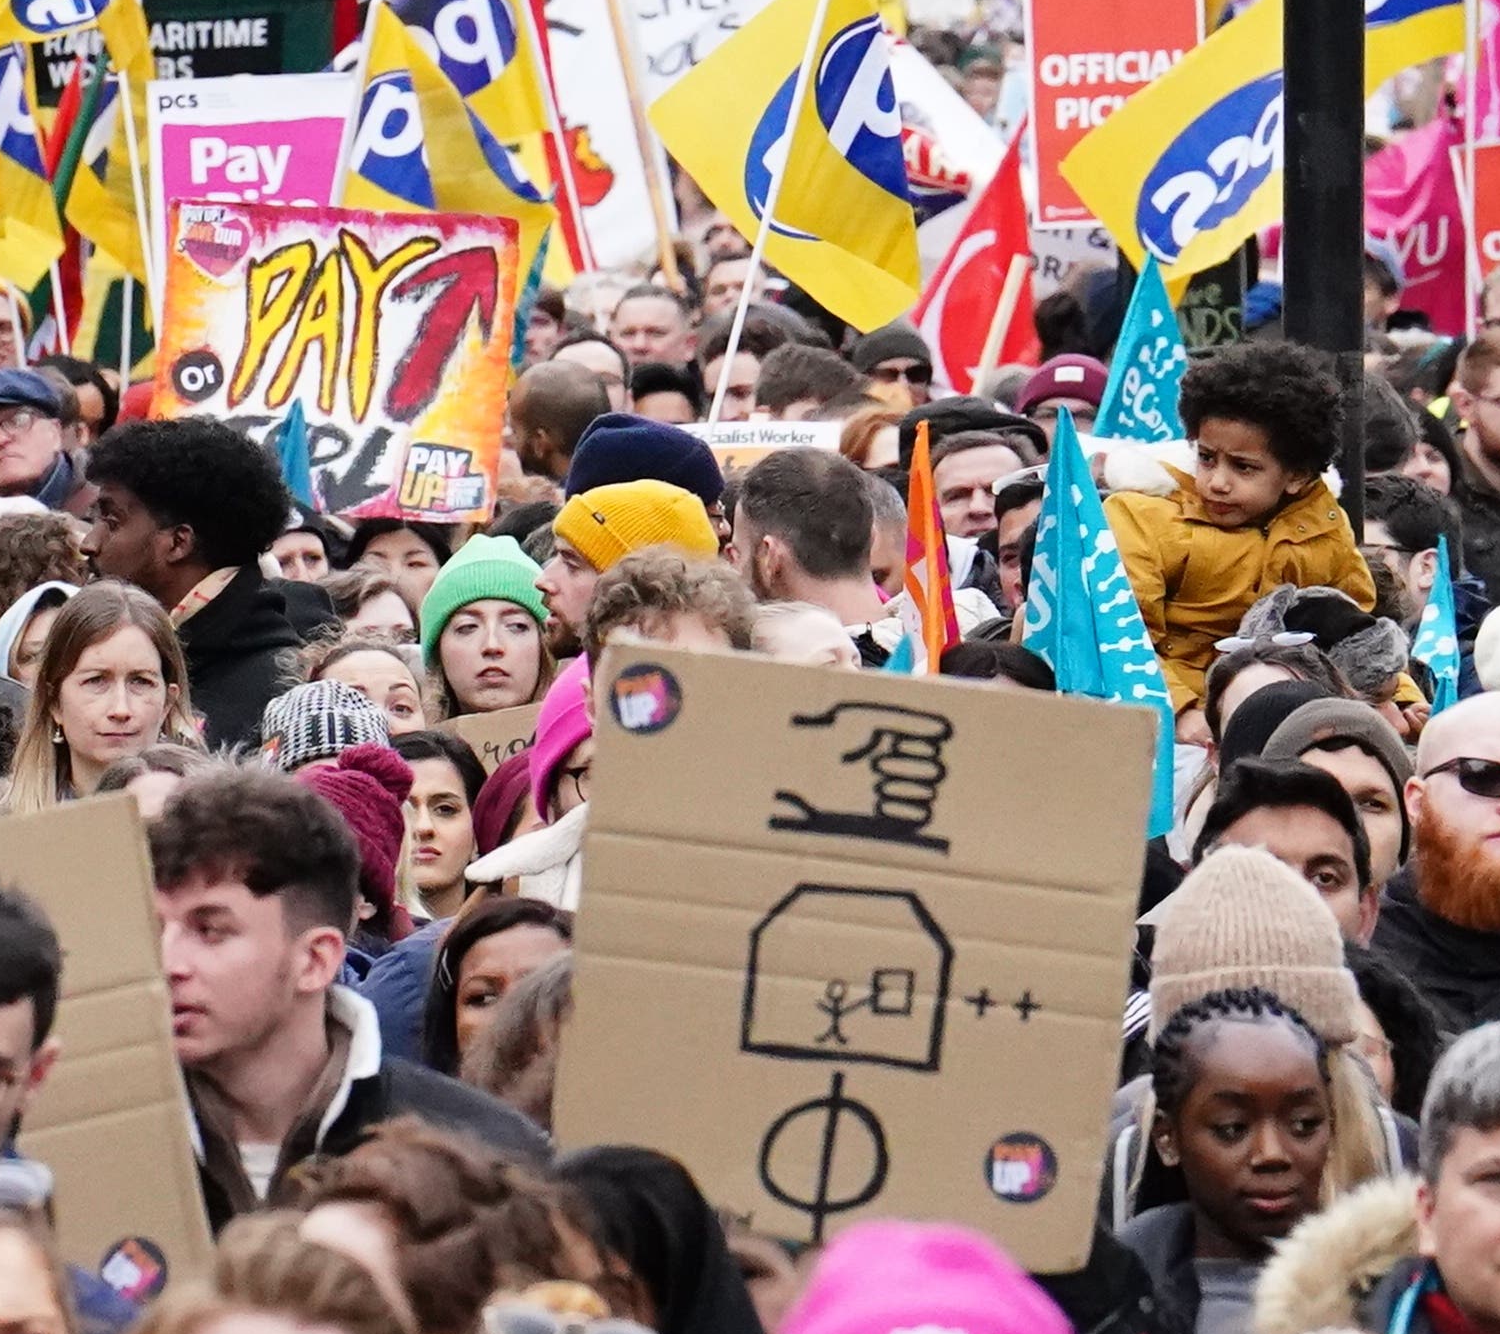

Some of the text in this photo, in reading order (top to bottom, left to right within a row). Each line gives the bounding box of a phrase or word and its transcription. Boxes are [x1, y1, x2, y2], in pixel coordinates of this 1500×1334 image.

[149, 17, 270, 52] ARITIME
[159, 94, 198, 113] pcs
[189, 136, 292, 195] Pay
[228, 227, 442, 424] PAY
[179, 363, 217, 393] Or
[757, 428, 817, 445] Worker
[410, 447, 468, 477] PAY
